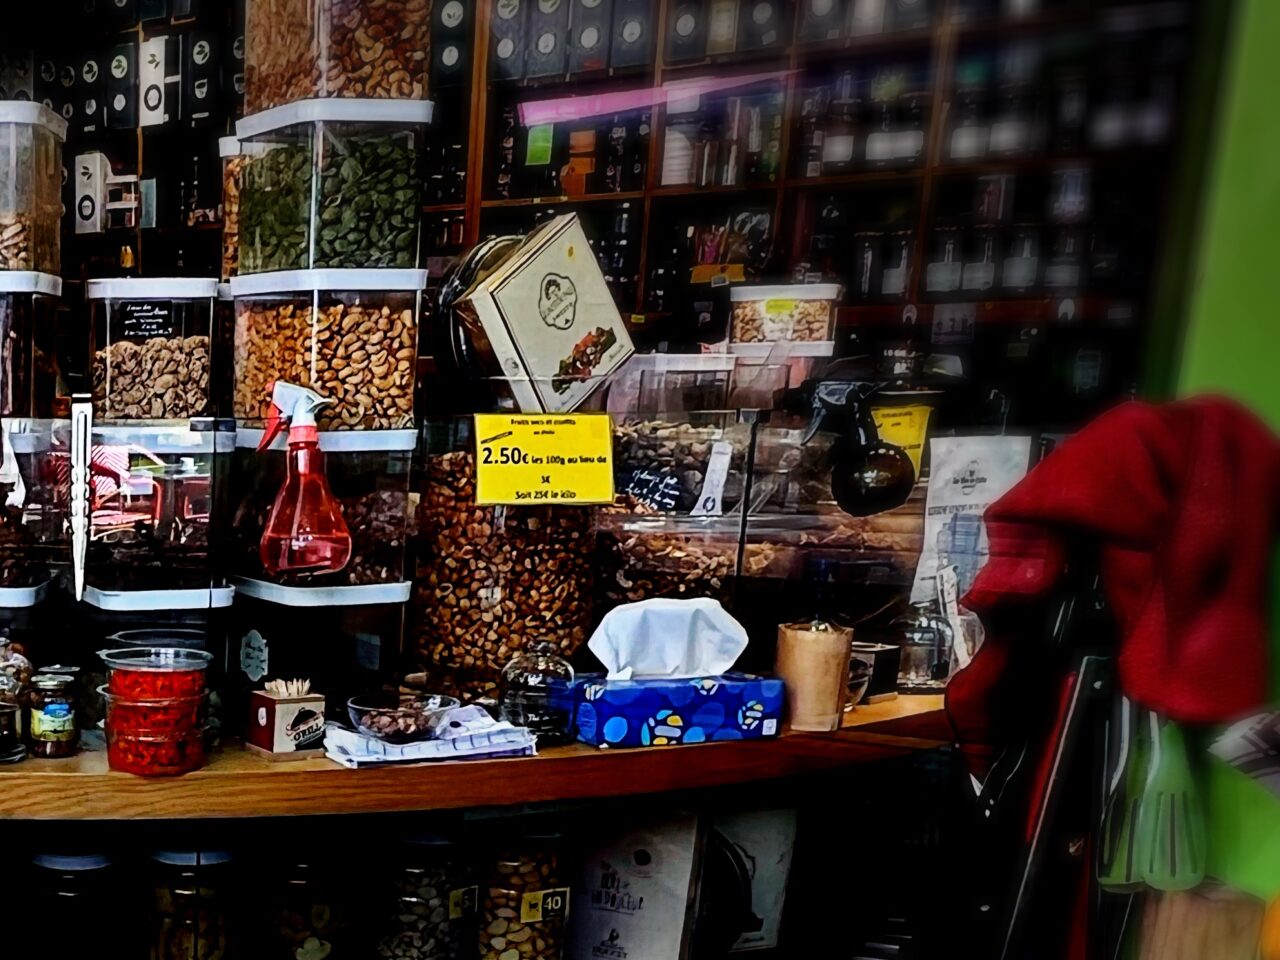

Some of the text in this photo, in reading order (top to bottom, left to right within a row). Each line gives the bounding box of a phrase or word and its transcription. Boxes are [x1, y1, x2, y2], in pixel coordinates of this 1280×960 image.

[482, 446, 529, 465] 2.50€
[545, 455, 566, 466] 100g
[596, 456, 607, 464] de
[515, 490, 531, 500] Soit
[551, 490, 559, 499] le
[560, 489, 577, 499] kilo
[545, 896, 562, 910] 40
